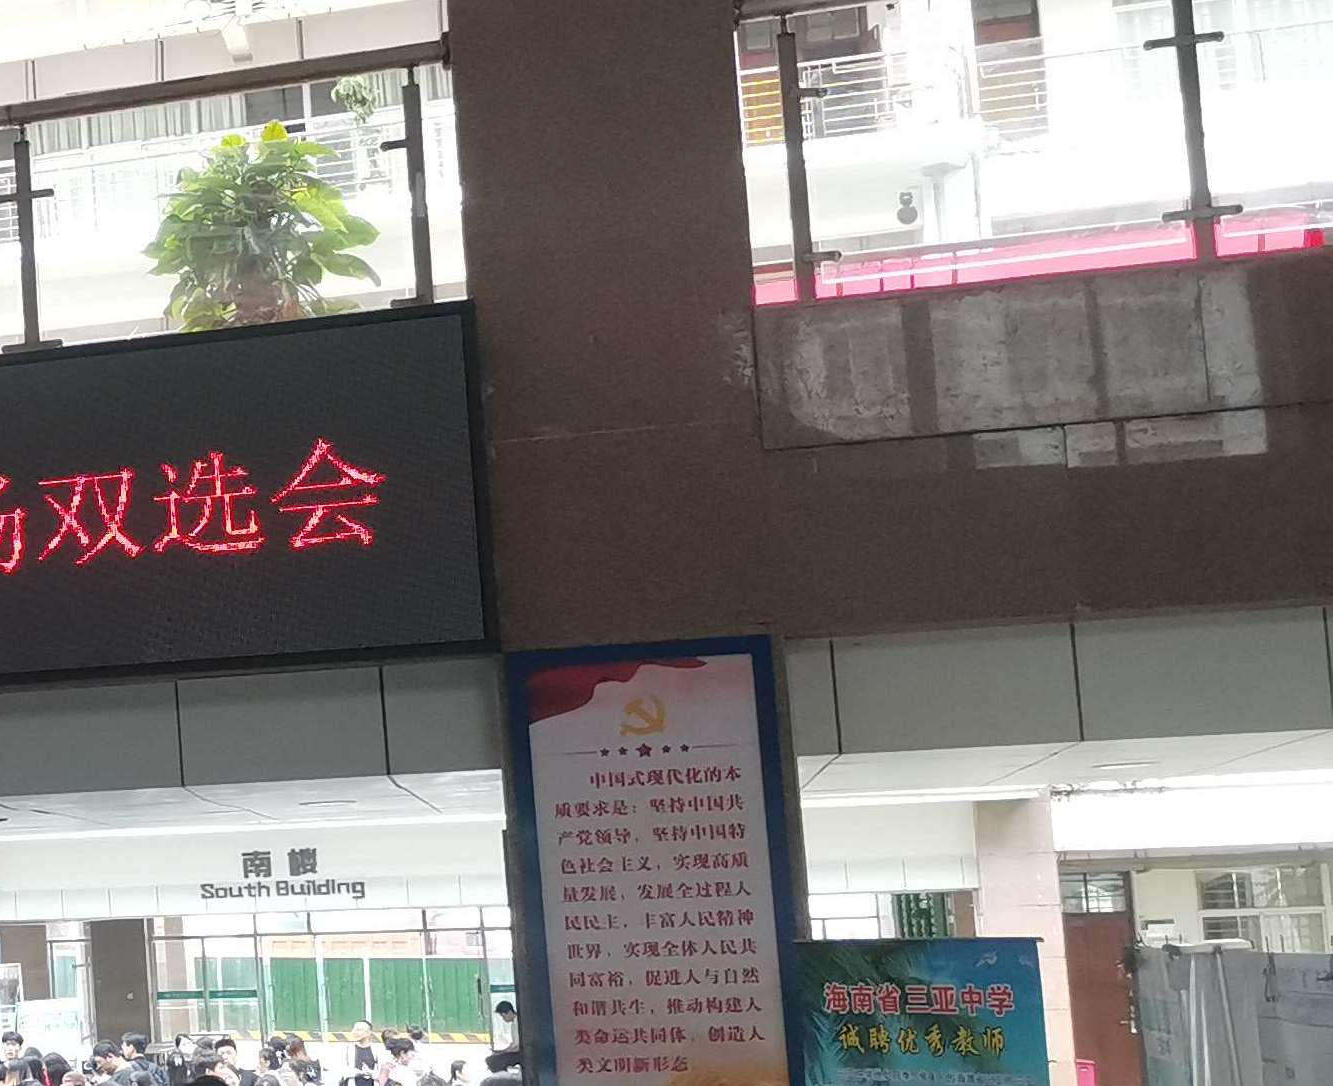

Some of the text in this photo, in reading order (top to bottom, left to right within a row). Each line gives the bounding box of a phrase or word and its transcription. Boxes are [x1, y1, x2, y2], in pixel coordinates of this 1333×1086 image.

[590, 766, 741, 790] 中国式现代化的本
[554, 794, 744, 818] 质要求是：坚持中国共
[241, 848, 319, 878] 南楼
[201, 880, 366, 899] South Building
[823, 982, 1015, 1017] 海南省三亚中学
[836, 1022, 1007, 1057] 诚聘优秀教师
[577, 1056, 689, 1075] 类文明新形态
